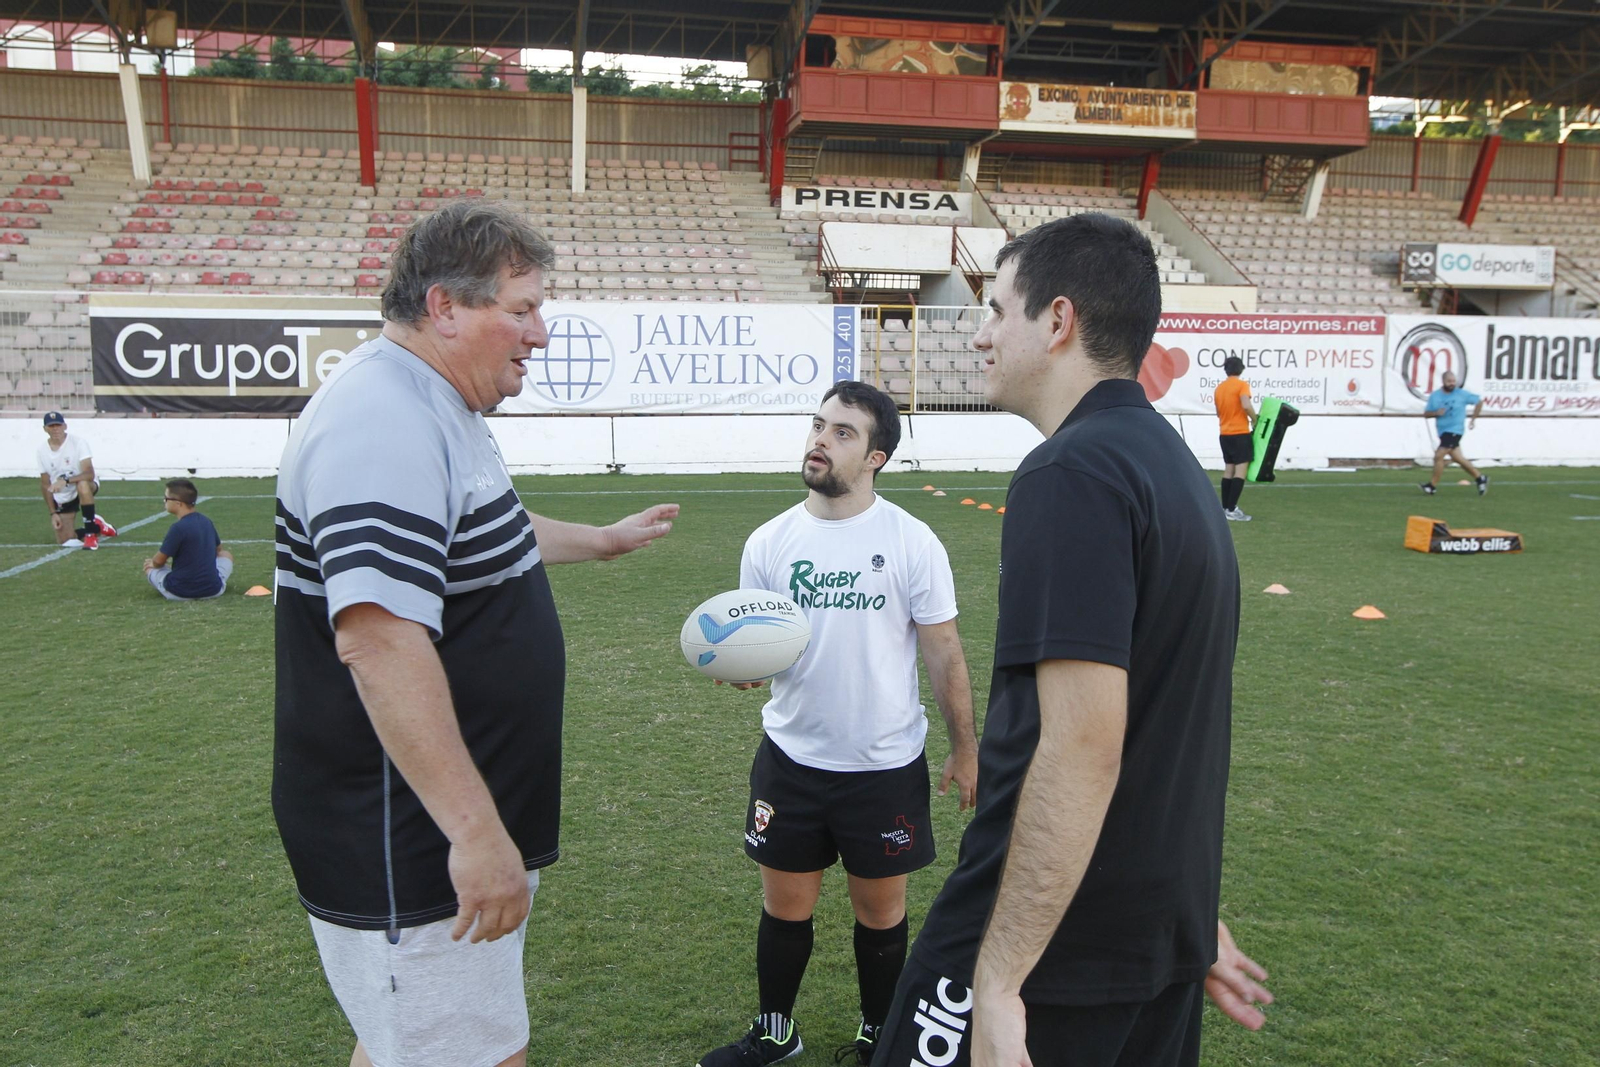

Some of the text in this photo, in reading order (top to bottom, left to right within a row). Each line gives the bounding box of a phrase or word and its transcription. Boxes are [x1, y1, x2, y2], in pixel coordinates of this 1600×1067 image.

[1087, 90, 1172, 107] AYUNTAMIENTO
[1176, 93, 1190, 108] DE
[795, 188, 960, 211] PRENSA
[630, 314, 757, 354] JAIME
[837, 315, 851, 341] 401
[1157, 317, 1377, 334] www.conectapymes.net
[115, 322, 368, 397] GrupoTe
[837, 348, 851, 374] 251
[1305, 349, 1374, 368] PYMES
[630, 353, 819, 385] AVELINO
[1265, 377, 1321, 389] Acreditado
[630, 392, 818, 405] BUFETE DE ABOGADOS
[1440, 538, 1511, 551] webb ellis
[728, 601, 793, 618] OFFLOAD
